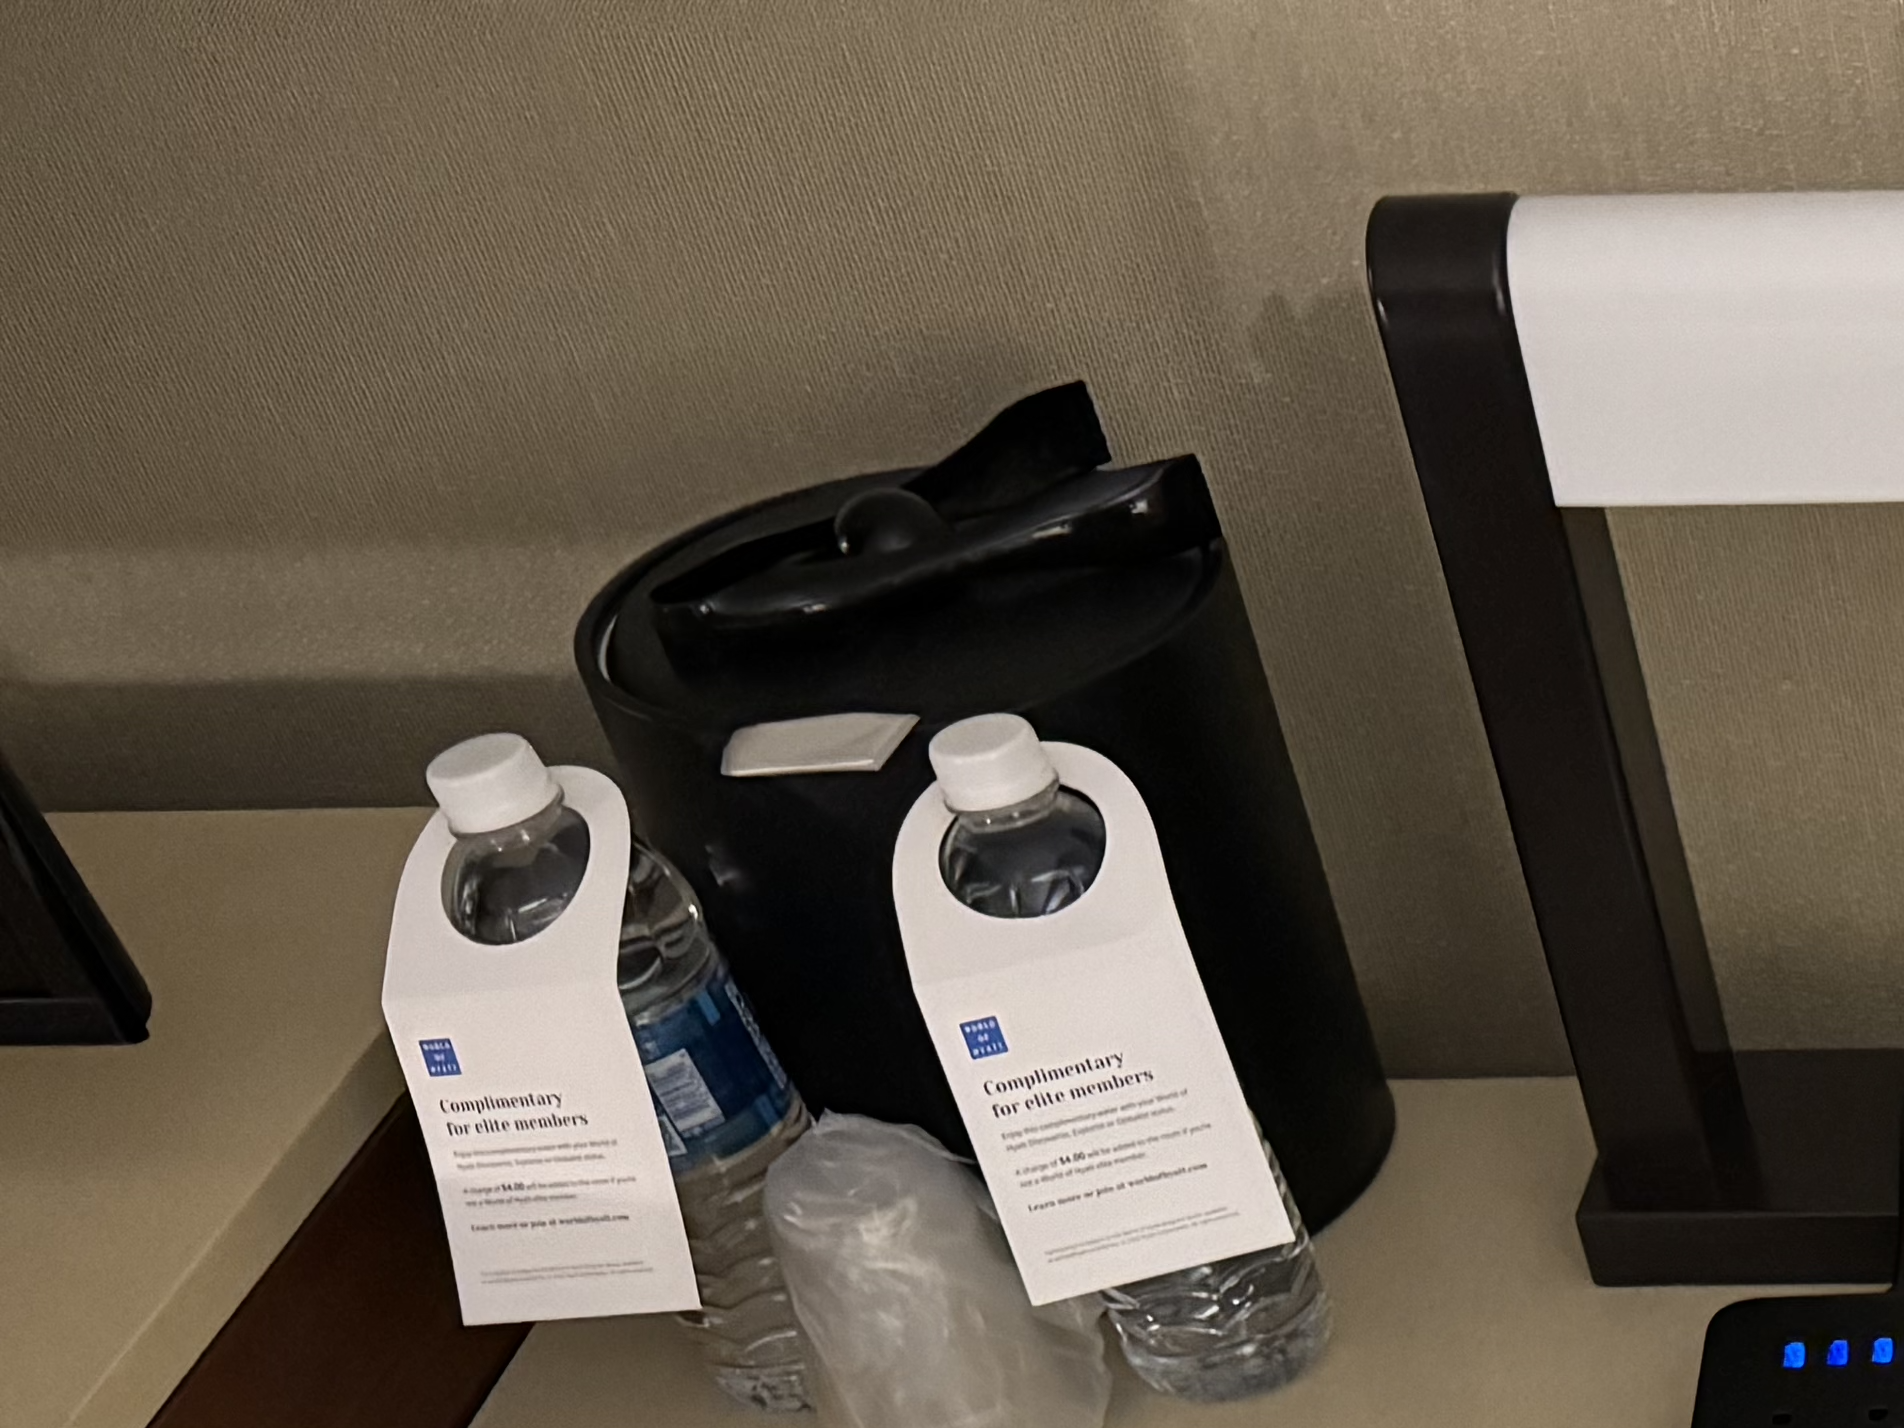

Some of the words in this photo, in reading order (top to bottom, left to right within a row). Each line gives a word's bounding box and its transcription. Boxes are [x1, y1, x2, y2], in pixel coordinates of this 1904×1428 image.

[983, 1052, 1124, 1096] Complimentary
[439, 1092, 563, 1115] Complimentary
[991, 1102, 1020, 1119] for
[1025, 1091, 1065, 1112] elite
[1069, 1069, 1154, 1100] members
[446, 1121, 471, 1138] for
[475, 1118, 511, 1136] elite
[514, 1113, 589, 1133] members
